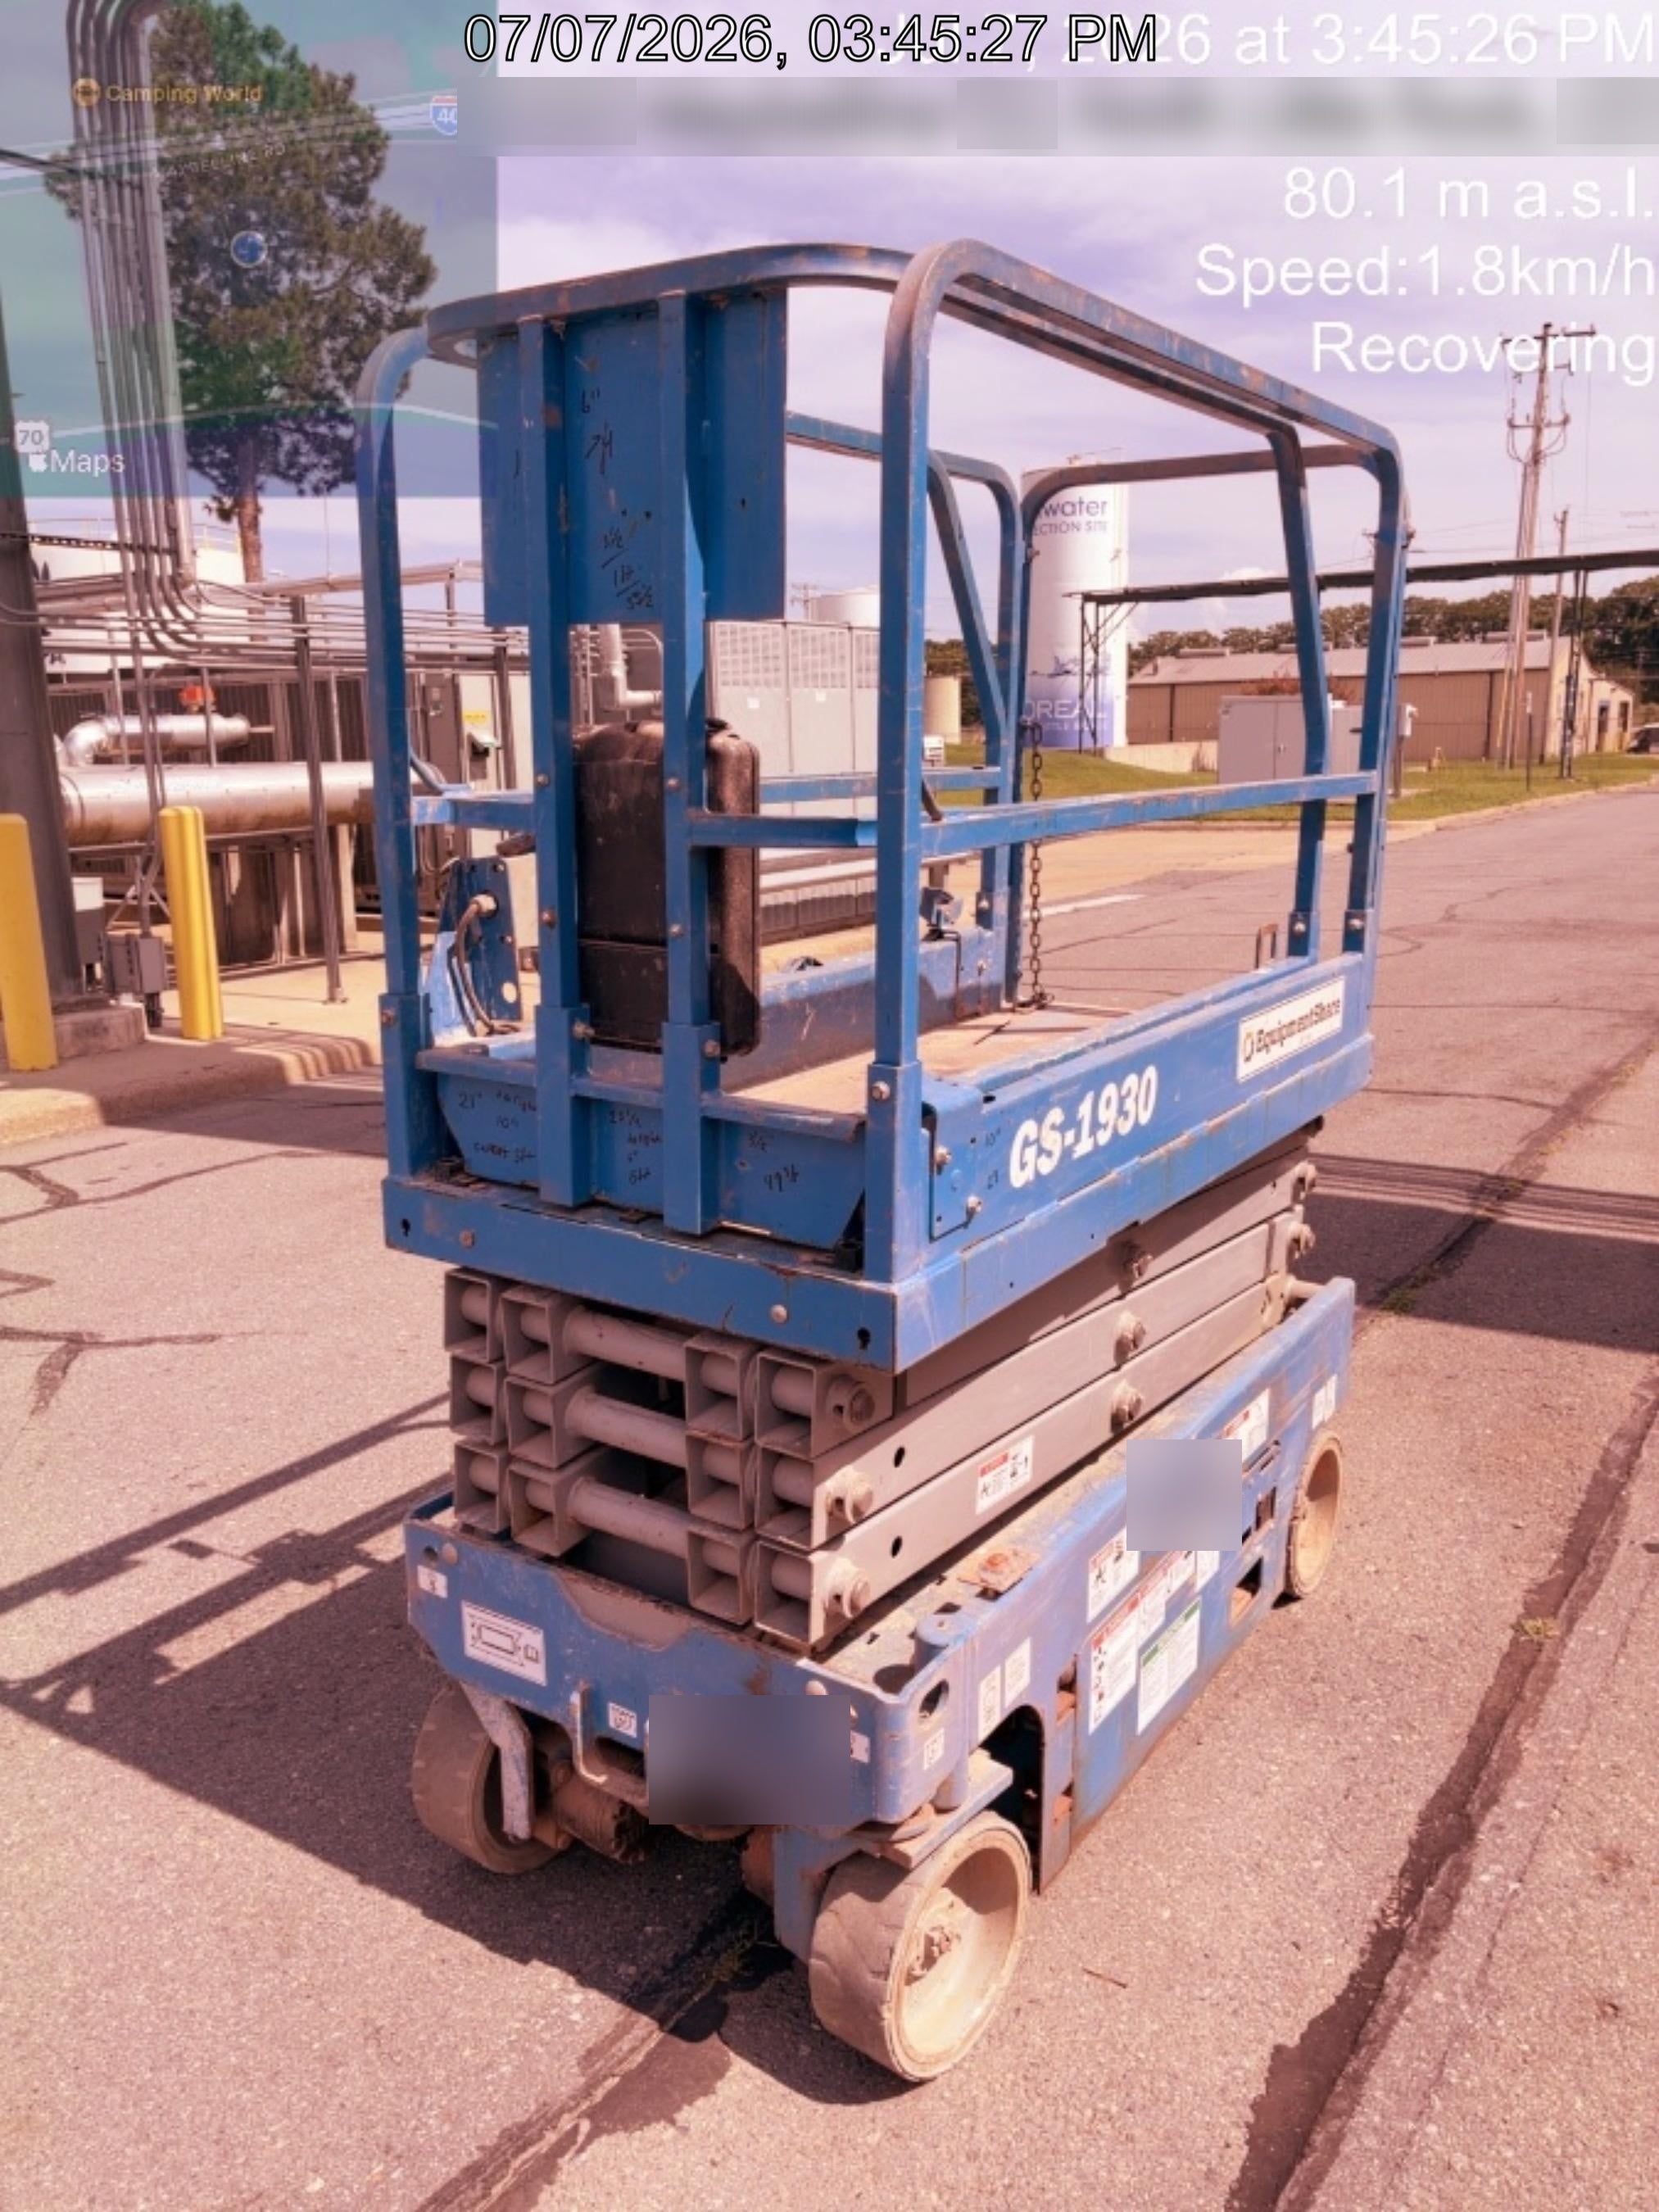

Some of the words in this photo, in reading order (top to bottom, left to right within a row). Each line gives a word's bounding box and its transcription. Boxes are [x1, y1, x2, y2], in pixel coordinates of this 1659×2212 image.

[1040, 496, 1108, 518] water
[1255, 998, 1341, 1054] EquipmentShare
[1009, 1063, 1160, 1190] GS-1930
